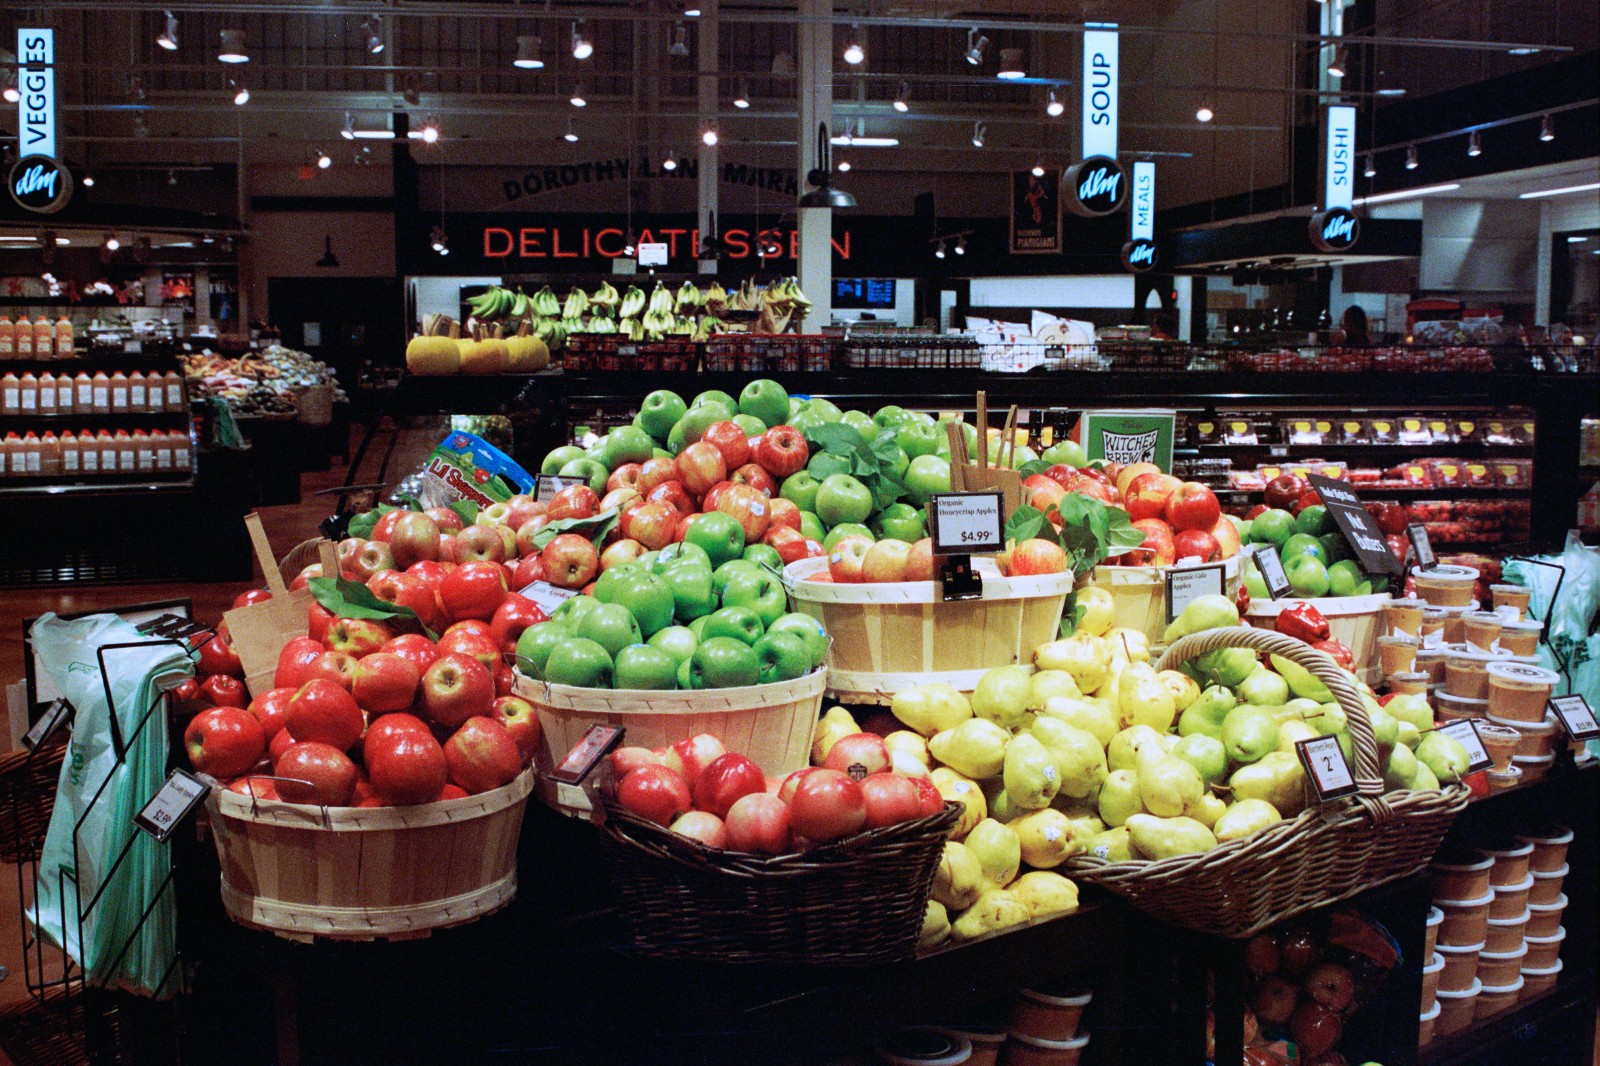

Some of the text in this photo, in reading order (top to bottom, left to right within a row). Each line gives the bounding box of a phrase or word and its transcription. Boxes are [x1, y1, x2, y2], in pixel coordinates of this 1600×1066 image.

[26, 36, 47, 145] VEGGIES
[1092, 52, 1111, 126] SOUP
[502, 158, 629, 201] DOROTHY
[1334, 127, 1349, 186] SUSHI
[1138, 175, 1151, 226] MEALS
[1105, 432, 1156, 452] WITCHES
[939, 507, 997, 517] Honeycrisp Apples
[1344, 511, 1368, 531] Nut
